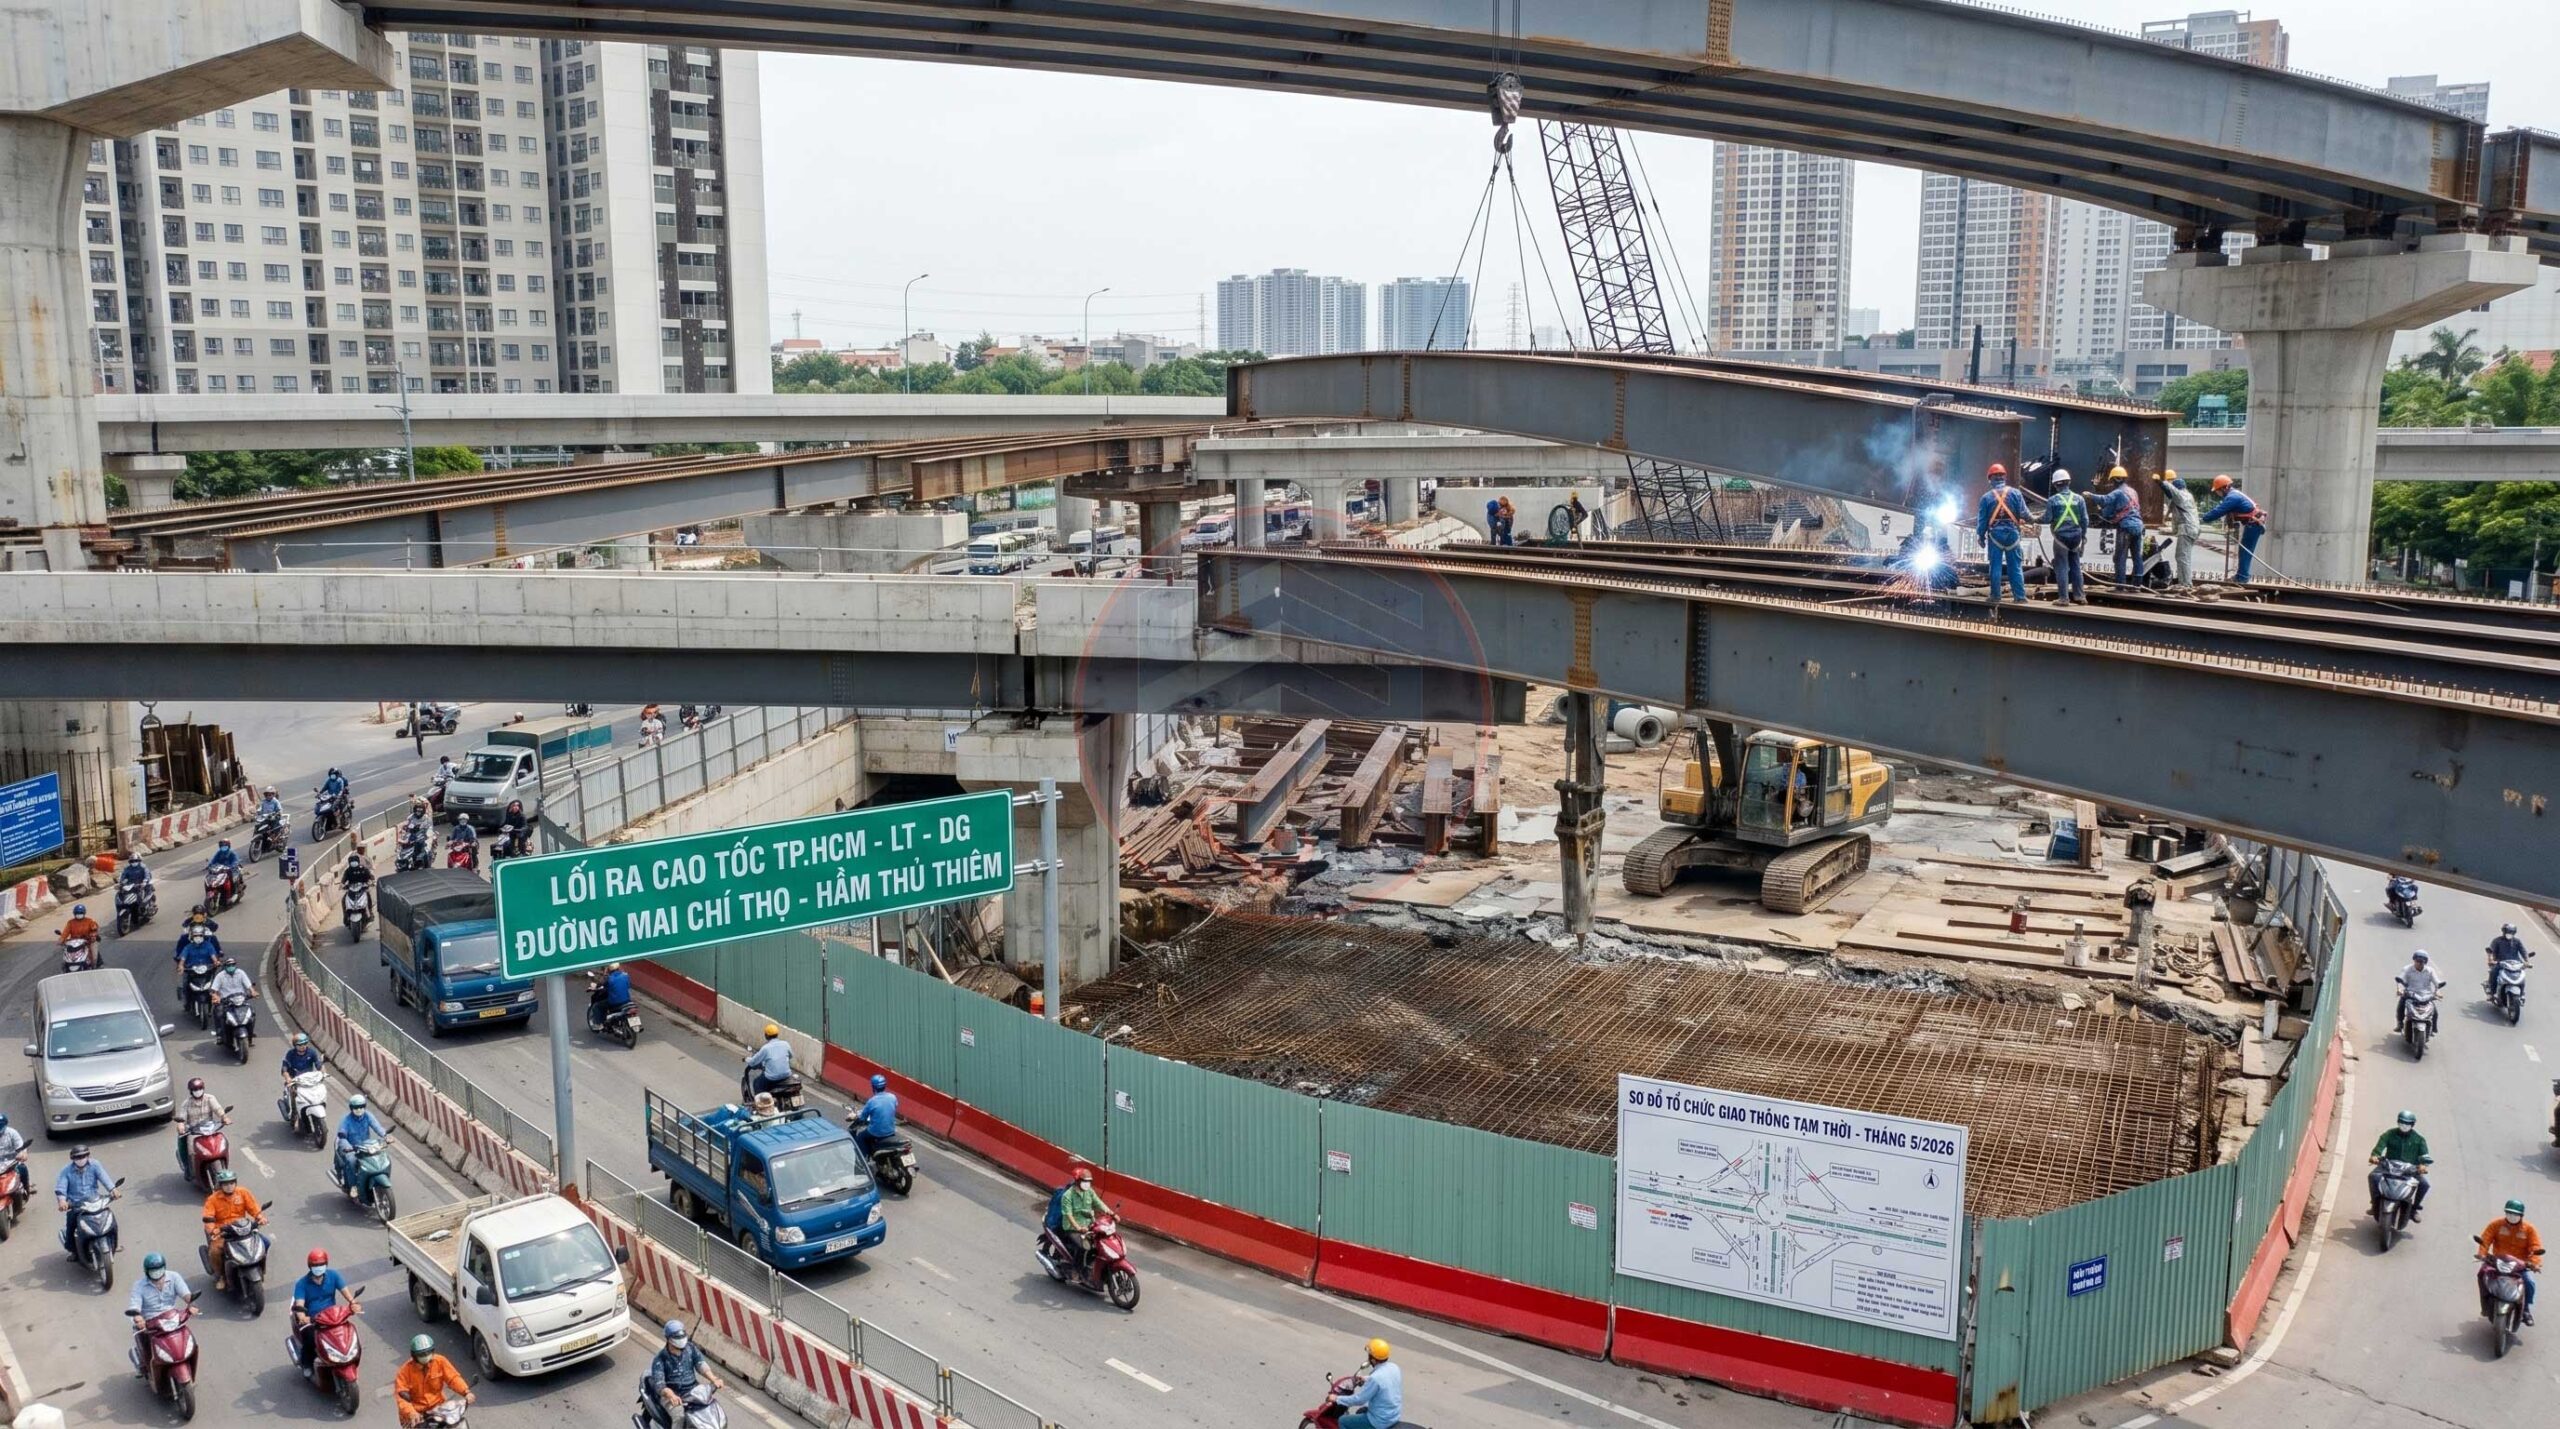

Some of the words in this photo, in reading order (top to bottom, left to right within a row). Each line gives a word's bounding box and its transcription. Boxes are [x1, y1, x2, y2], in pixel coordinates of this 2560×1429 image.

[515, 915, 618, 961] ĐƯỜNG
[627, 905, 678, 942] MAI
[687, 889, 731, 931] CHÍ
[738, 887, 790, 922] THỌ
[816, 866, 871, 909] HẦM
[878, 856, 925, 897] THỦ
[932, 848, 1002, 888] THIÊM
[551, 859, 596, 906] LỐI
[605, 864, 644, 898] RA
[652, 854, 706, 890] CAO
[714, 836, 765, 879] TỐC
[773, 829, 866, 870] TP.HCM
[891, 822, 916, 852] LT
[939, 814, 971, 844] DG
[1683, 1098, 1715, 1117] CHỨC
[1718, 1104, 1747, 1122] GIAO
[1793, 1116, 1819, 1136] TẠM
[1822, 1119, 1852, 1140] THỜI
[1863, 1126, 1906, 1148] THÁNG
[1910, 1135, 1955, 1156] 5/2026
